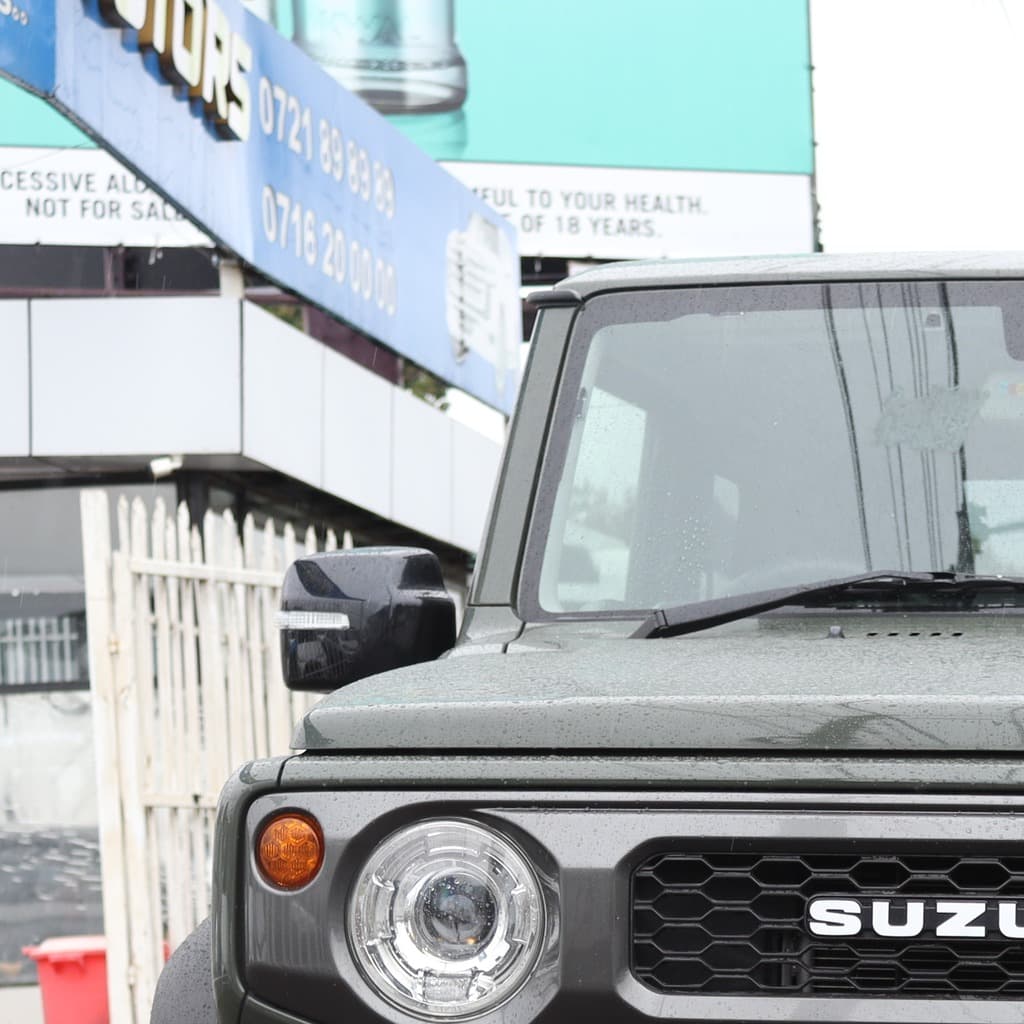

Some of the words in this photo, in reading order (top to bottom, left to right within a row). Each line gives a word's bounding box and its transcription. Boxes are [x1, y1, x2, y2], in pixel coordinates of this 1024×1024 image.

[259, 77, 313, 161] 0721
[26, 197, 71, 218] NOT
[80, 199, 121, 220] FOR
[526, 189, 552, 209] TO
[561, 191, 616, 211] YOUR
[262, 184, 317, 266] 0716
[322, 221, 346, 283] 20
[521, 213, 545, 233] OF
[556, 215, 580, 234] 18
